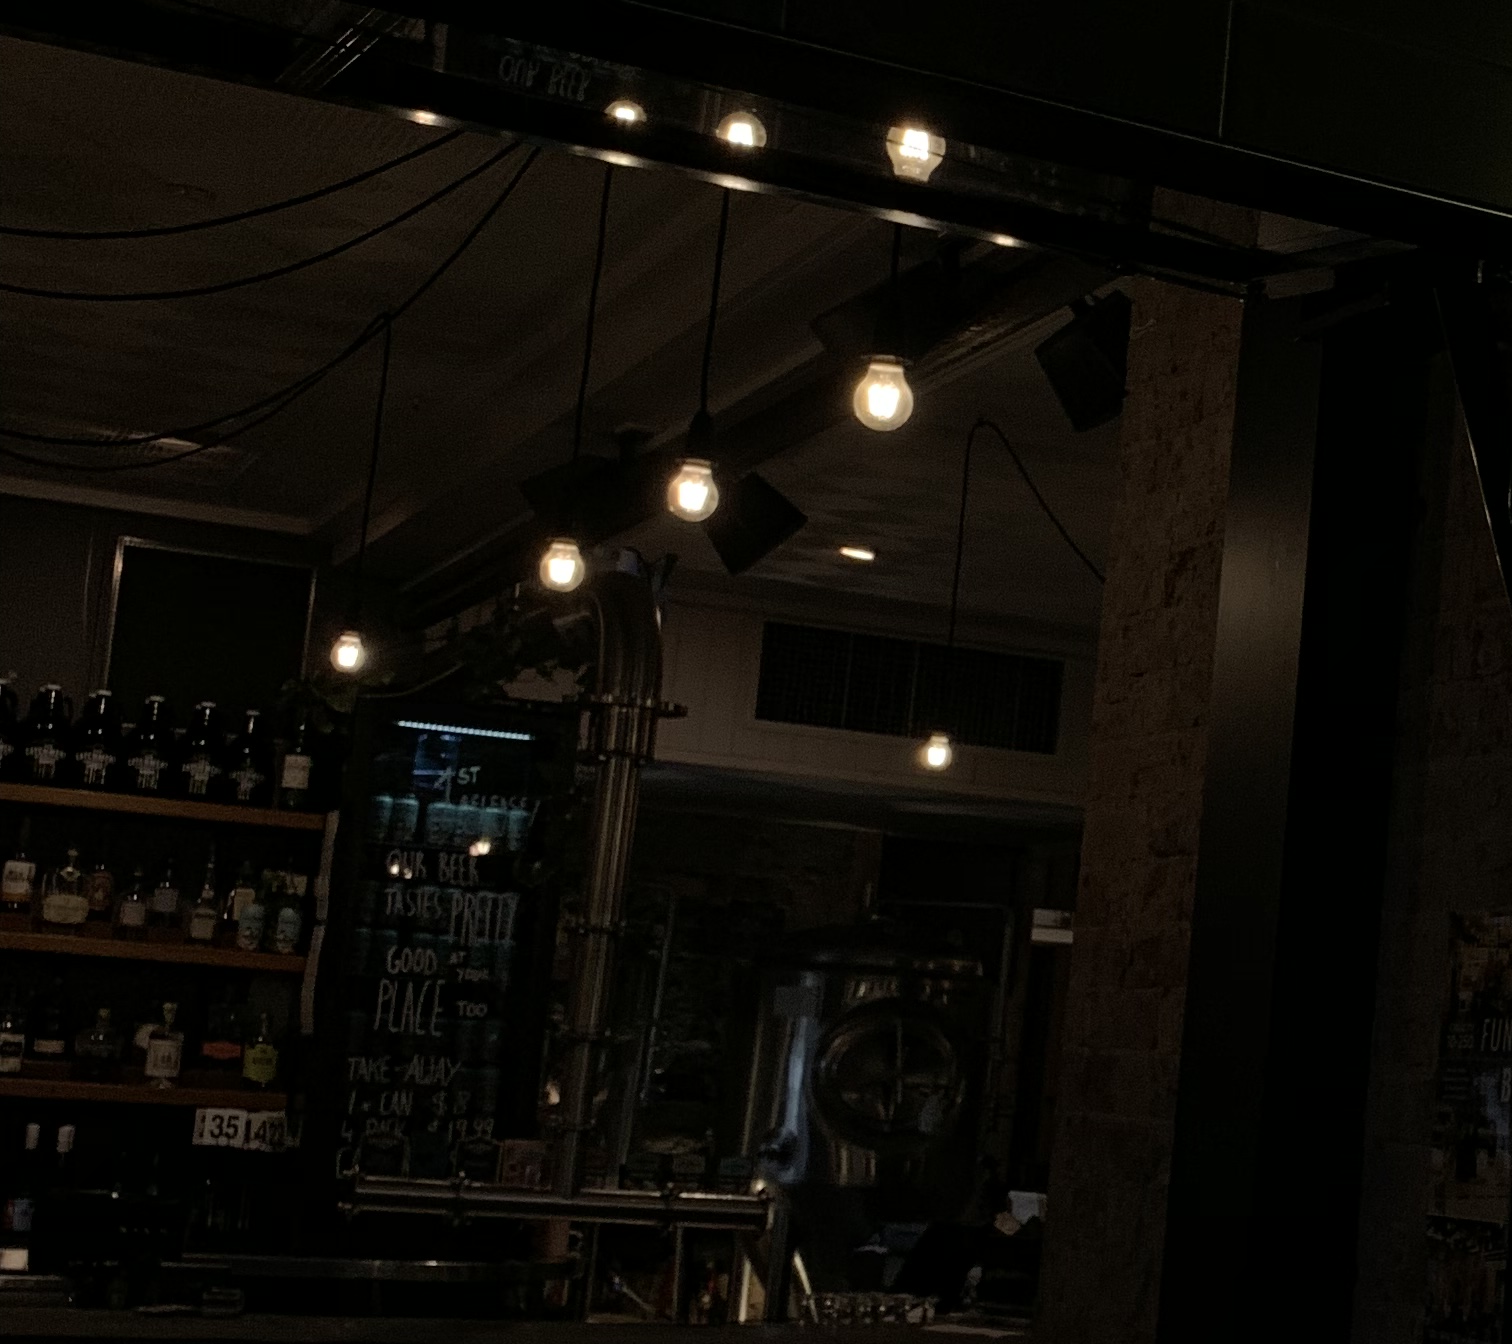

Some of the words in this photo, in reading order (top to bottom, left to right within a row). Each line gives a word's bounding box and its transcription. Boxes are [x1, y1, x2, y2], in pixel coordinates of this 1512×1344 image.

[386, 849, 427, 879] OUR
[438, 851, 480, 886] BEER
[384, 885, 442, 918] TASTES
[449, 890, 521, 945] PRETTY
[387, 945, 439, 976] GOOD
[373, 977, 446, 1038] PLACE
[455, 1000, 489, 1019] TOO
